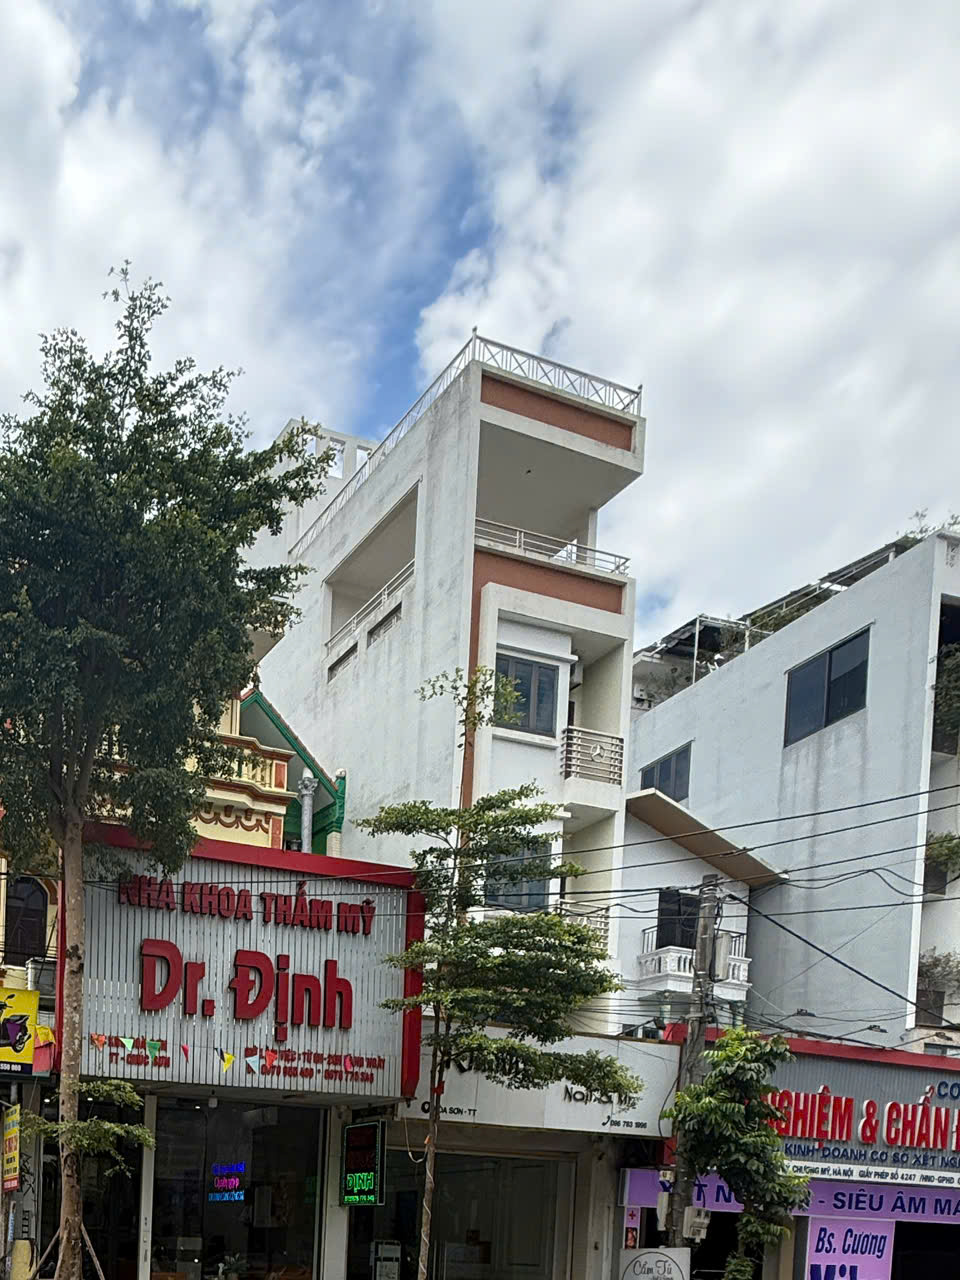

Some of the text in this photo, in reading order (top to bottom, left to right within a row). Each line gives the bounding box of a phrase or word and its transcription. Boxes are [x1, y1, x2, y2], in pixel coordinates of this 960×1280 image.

[119, 874, 176, 911] NHA
[182, 881, 254, 921] KHOA
[337, 898, 376, 936] MỸ
[141, 938, 353, 1042] Dr. Định
[858, 1100, 880, 1144] &
[883, 1085, 950, 1150] CHẨN
[784, 1143, 815, 1157] KINH
[820, 1146, 867, 1161] DOANH
[900, 1173, 916, 1181] 4247
[832, 1189, 884, 1212] SIÊU
[891, 1191, 926, 1215] ÂM
[815, 1227, 887, 1259] Bs. Cương
